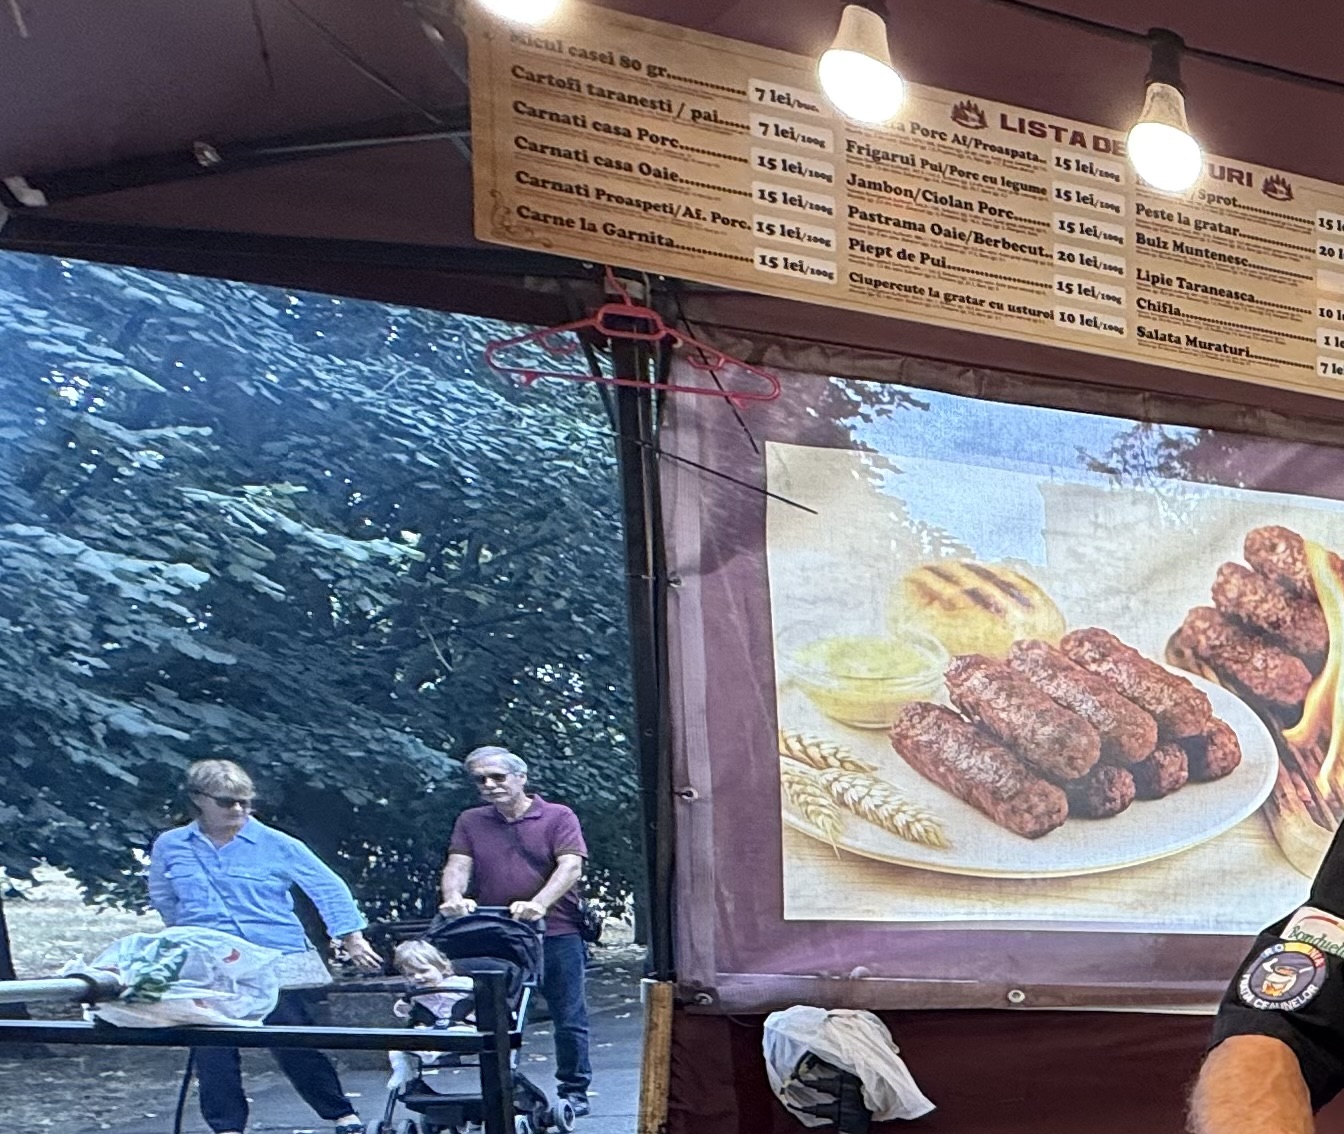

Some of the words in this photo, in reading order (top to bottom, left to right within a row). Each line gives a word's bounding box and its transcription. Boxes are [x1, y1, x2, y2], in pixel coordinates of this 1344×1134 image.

[511, 64, 581, 93] Cartofi
[587, 80, 673, 114] taranesti
[759, 122, 768, 136] 7
[568, 44, 615, 66] casei
[619, 54, 642, 72] 80
[755, 88, 765, 102] 7
[513, 100, 587, 129] Carnati
[592, 120, 632, 139] casa
[757, 155, 777, 171] 15
[910, 121, 948, 142] Porc
[1054, 155, 1072, 168] 15
[1000, 111, 1087, 149] LISTA
[514, 135, 588, 164] Carnati
[593, 155, 633, 174] casa
[758, 188, 778, 204] 15
[845, 139, 917, 167] Frigarui
[920, 159, 979, 183] Pui/Porc
[982, 173, 998, 184] cu
[1000, 176, 1047, 199] legume
[1055, 187, 1072, 201] 15
[515, 170, 590, 199] Carnati
[756, 220, 775, 236] 15
[846, 172, 974, 212] Jambon/Ciolan
[1058, 219, 1076, 234] 15
[1135, 203, 1174, 223] Peste
[1177, 211, 1191, 226] la
[1194, 218, 1240, 240] gratar
[1319, 245, 1336, 259] 20
[1197, 187, 1239, 210] Sprot
[1318, 217, 1334, 231] 15
[516, 204, 575, 230] Carne
[580, 216, 598, 234] la
[602, 221, 677, 248] Garnita
[758, 253, 778, 269] 15
[847, 204, 926, 234] Pastrama
[1057, 250, 1076, 263] 20
[1135, 232, 1170, 252] Bulz
[1172, 239, 1250, 268] Muntenesc
[848, 237, 893, 262] Piept
[896, 247, 916, 262] de
[1057, 280, 1074, 295] 15
[1136, 268, 1174, 291] Lipie
[1176, 276, 1256, 304] Taraneasca
[1318, 306, 1334, 319] 10
[848, 271, 925, 300] Ciupercute
[928, 285, 941, 299] la
[943, 290, 986, 311] gratar
[988, 299, 1005, 311] cu
[1007, 302, 1055, 322] usturoi
[1059, 311, 1076, 324] 10
[1136, 297, 1182, 319] Chifla
[1324, 335, 1331, 347] 1
[1136, 325, 1182, 347] Salata
[1184, 333, 1252, 360] Muraturi
[1320, 361, 1328, 375] 7
